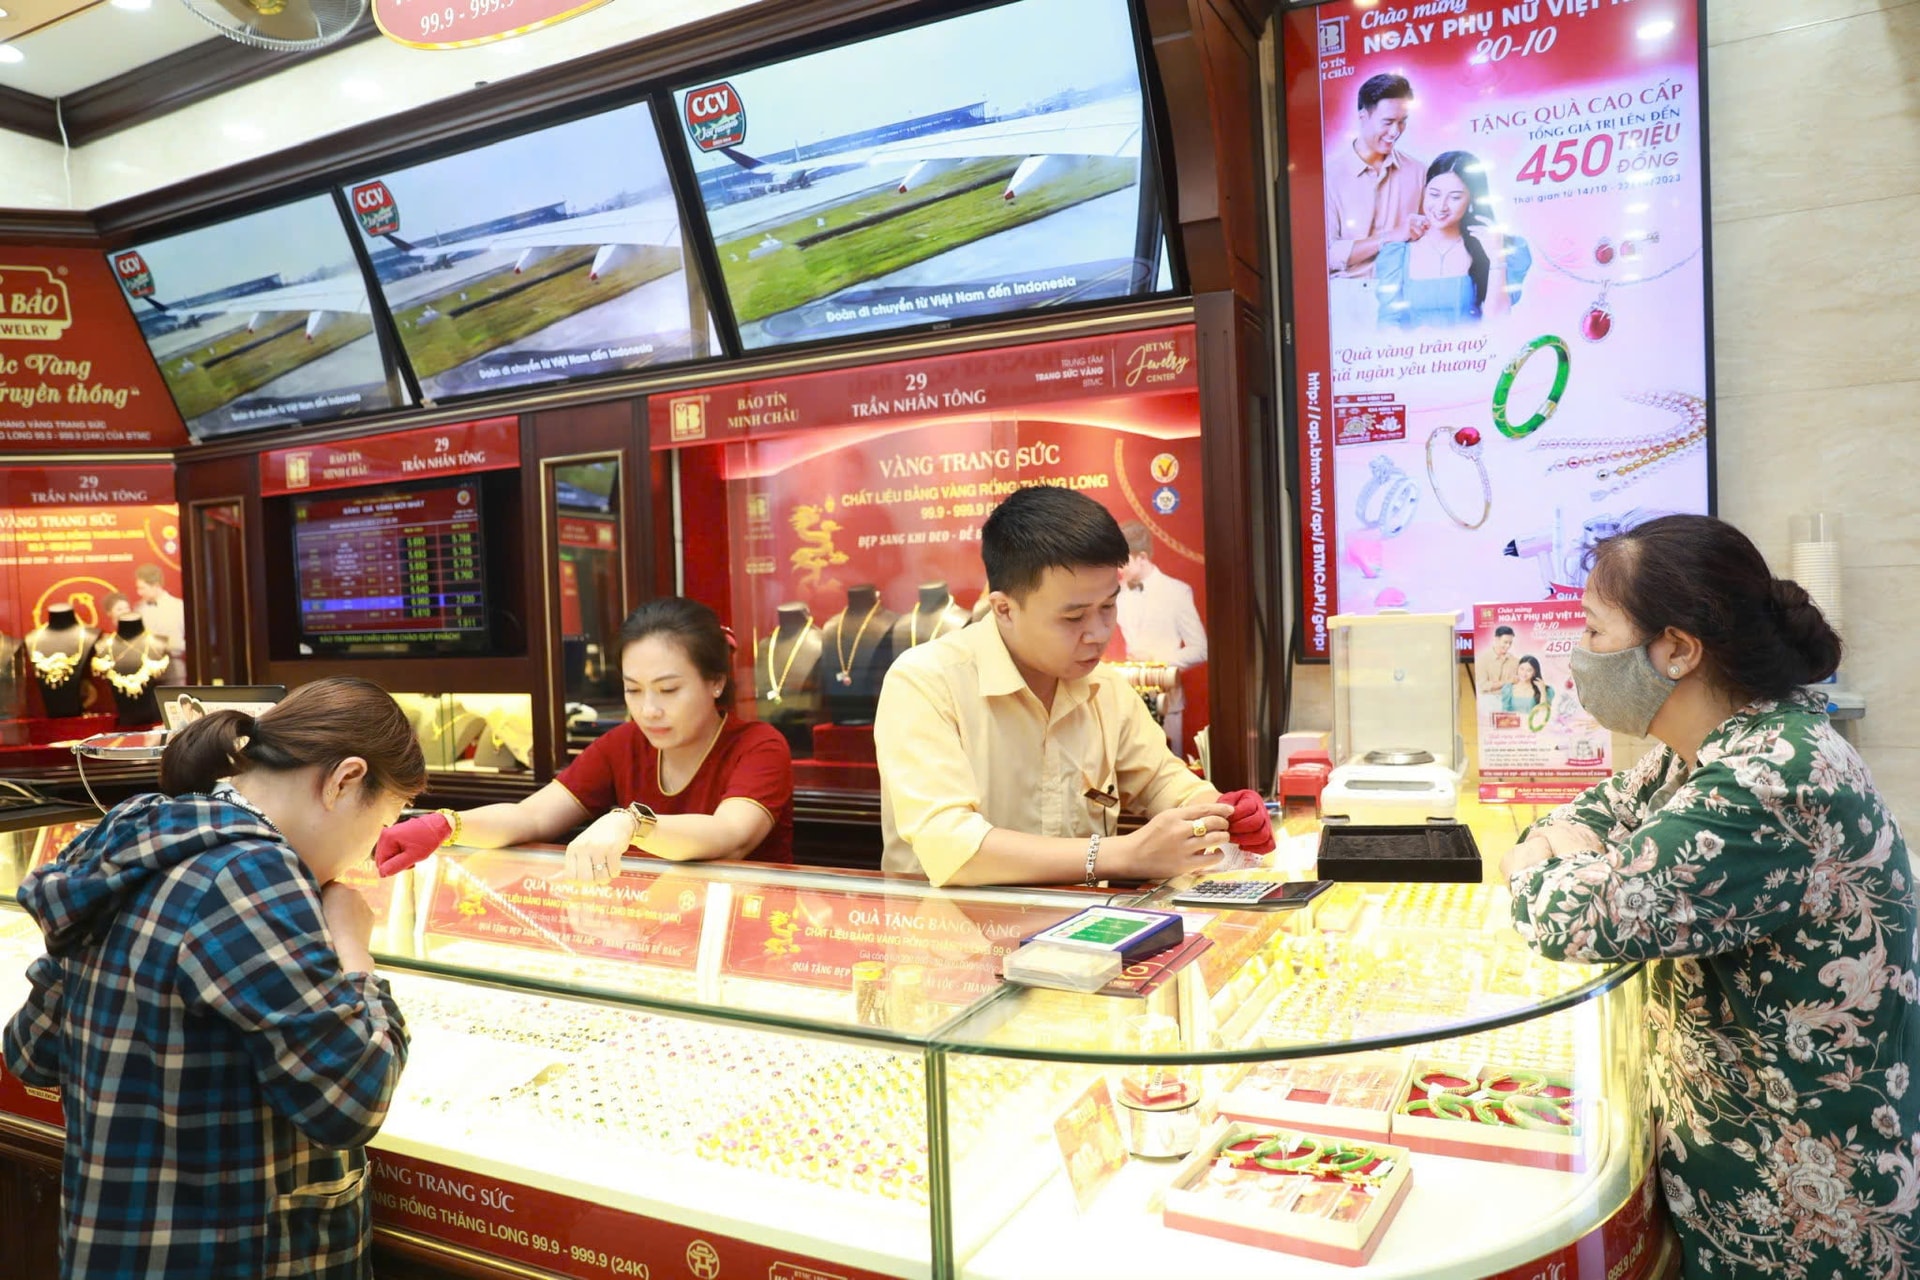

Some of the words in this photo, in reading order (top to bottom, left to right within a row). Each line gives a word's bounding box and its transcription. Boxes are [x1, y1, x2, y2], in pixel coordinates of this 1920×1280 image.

[420, 7, 454, 36] 99.9
[1361, 7, 1408, 29] Chào
[1364, 22, 1434, 54] NGÀY
[1443, 11, 1493, 37] PHỤ
[1503, 0, 1540, 27] NỮ
[1470, 26, 1557, 65] 20-10
[1330, 57, 1346, 68] TÍN
[692, 90, 729, 117] CCV
[1470, 111, 1527, 135] TẶNG
[1534, 98, 1580, 125] QUÀ
[1588, 93, 1632, 114] CAO
[1639, 78, 1684, 104] CẤP
[1529, 123, 1564, 141] TỔNG
[1568, 121, 1591, 134] GIÁ
[1596, 118, 1616, 131] TRỊ
[1620, 112, 1646, 127] LÊN
[1651, 105, 1680, 122] ĐẾN
[1516, 133, 1614, 186] 450
[1618, 120, 1681, 151] TRIỆU
[1617, 151, 1679, 174] ĐỒNG
[358, 187, 384, 208] CCV
[1577, 185, 1607, 197] 14/10
[119, 256, 141, 274] CCV
[11, 287, 58, 315] BẢO
[826, 308, 857, 322] Đoàn
[858, 305, 870, 318] di
[872, 297, 914, 317] chuyển
[915, 297, 928, 310] từ
[929, 293, 953, 309] Việt
[956, 291, 985, 304] Nam
[987, 282, 1011, 300] đến
[1013, 275, 1076, 295] Indonesia
[1145, 341, 1175, 352] BTMC
[1377, 344, 1414, 360] vàng
[1419, 339, 1453, 355] trân
[1458, 335, 1488, 352] quý
[24, 354, 91, 380] Vàng
[1061, 356, 1086, 368] TRUNG
[1087, 355, 1104, 365] TÂM
[1126, 346, 1190, 387] Jewelry
[1356, 364, 1394, 382] ngàn
[1399, 361, 1426, 380] yêu
[905, 372, 928, 391] 29
[1035, 371, 1061, 381] TRANG
[1062, 367, 1078, 379] SỨC
[1080, 366, 1104, 377] VÀNG
[1083, 377, 1103, 387] BTMC
[1146, 373, 1175, 383] CENTER
[737, 393, 763, 411] BẢO
[767, 391, 787, 407] TÍN
[852, 394, 889, 417] TRẦN
[894, 393, 938, 412] NHÂN
[943, 388, 986, 408] TÔNG
[728, 413, 761, 429] MINH
[763, 408, 800, 424] CHÂU
[435, 437, 450, 452] 29
[402, 454, 426, 472] TRẦN
[427, 452, 456, 468] NHÂN
[458, 451, 486, 466] TÔNG
[879, 454, 934, 479] VÀNG
[940, 448, 1010, 474] TRANG
[1016, 441, 1061, 469] SỨC
[79, 475, 99, 489] 29
[842, 488, 873, 507] CHẤT
[875, 489, 902, 506] LIỆU
[941, 481, 977, 498] VÀNG
[979, 478, 1016, 496] RỒNG
[1069, 474, 1108, 490] LONG
[31, 488, 66, 503] TRẦN
[69, 489, 108, 501] NHÂN
[111, 489, 148, 501] TÔNG
[921, 505, 945, 520] 99.9
[953, 503, 985, 517] 999.9
[880, 533, 905, 546] SANG
[907, 532, 925, 544] KHI
[1498, 611, 1522, 622] NGÀY
[1523, 613, 1541, 622] PHỤ
[1557, 610, 1573, 621] VIỆT
[1574, 611, 1587, 619] NA
[1546, 641, 1571, 653] 450
[616, 886, 650, 902] VÀNG
[848, 909, 879, 926] QUÀ
[884, 913, 925, 931] TẶNG
[976, 919, 1021, 938] VÀNG
[876, 931, 900, 945] VÀNG
[792, 961, 810, 973] QUÀ
[811, 963, 832, 976] TẶNG
[416, 1171, 477, 1202] TRANG
[480, 1187, 515, 1213] SỨC
[400, 1195, 437, 1220] RỒNG
[439, 1208, 487, 1234] THĂNG
[489, 1223, 529, 1246] LONG
[532, 1234, 560, 1255] 99.9
[570, 1245, 608, 1268] 999.9
[611, 1255, 650, 1279] (24K)
